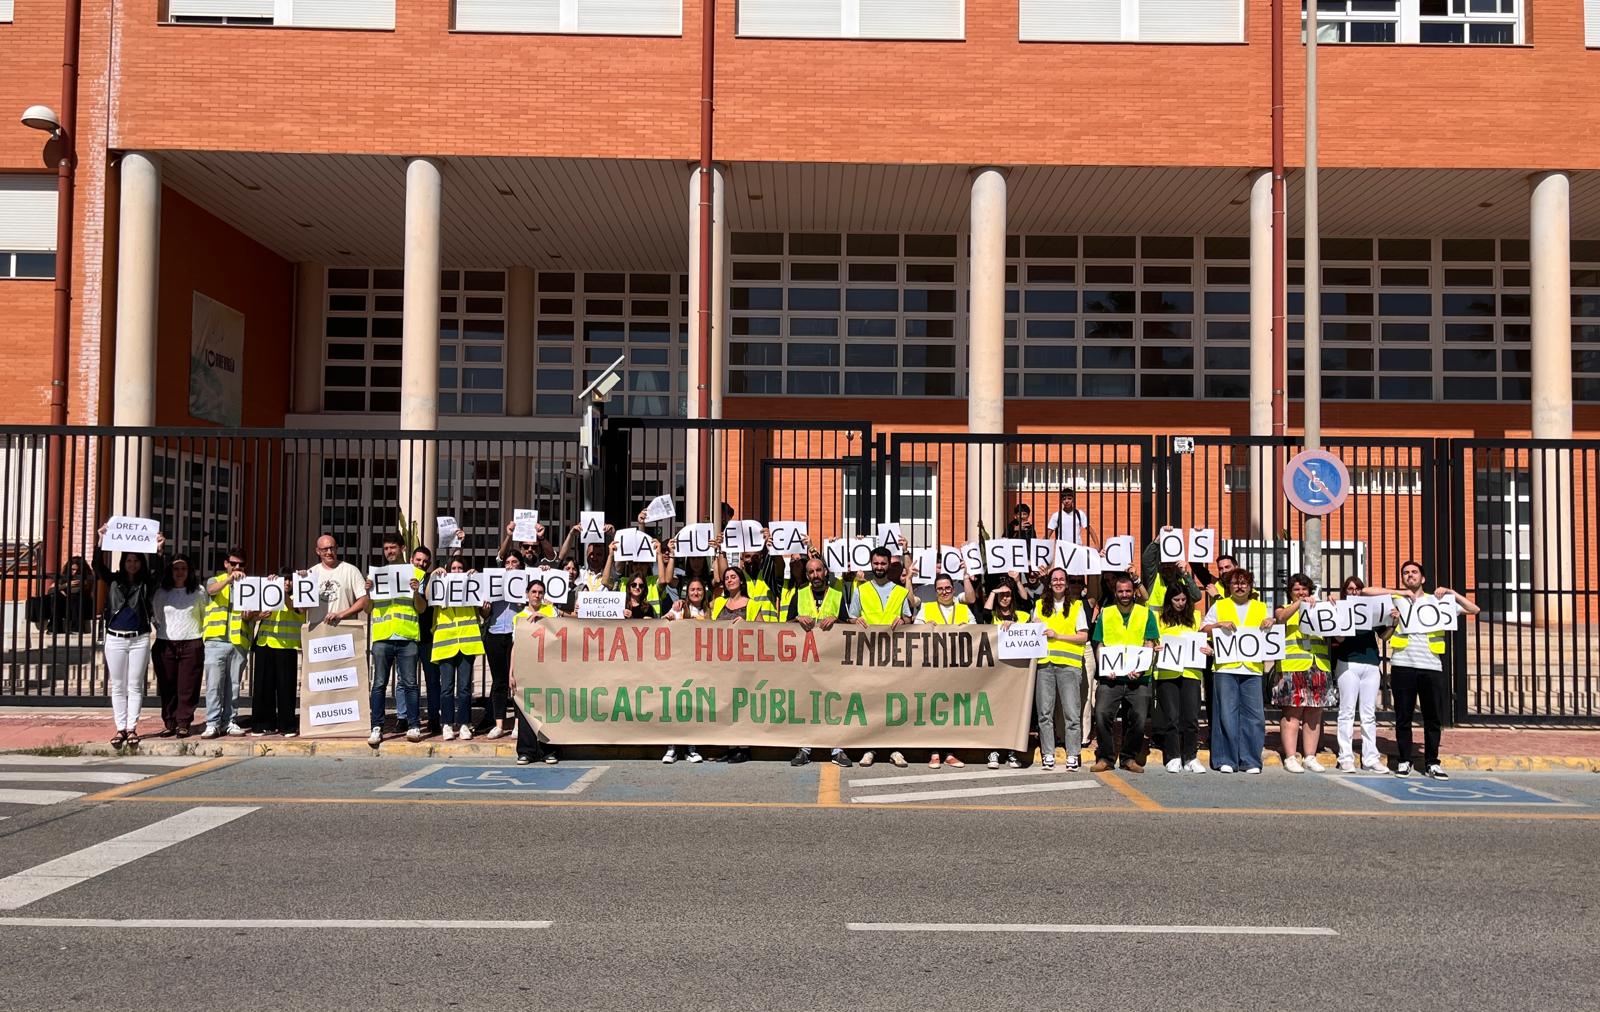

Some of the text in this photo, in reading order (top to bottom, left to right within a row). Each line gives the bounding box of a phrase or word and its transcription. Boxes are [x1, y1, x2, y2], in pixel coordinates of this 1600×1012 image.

[116, 522, 148, 531] DRET A
[111, 533, 150, 542] LA VAGA
[583, 518, 602, 539] A
[621, 536, 654, 557] LA
[676, 527, 805, 554] HUELGA
[827, 544, 871, 568] NO
[883, 529, 900, 550] A
[239, 580, 316, 607] POR
[375, 571, 410, 595] EL
[586, 610, 618, 618] HUELGA
[1008, 629, 1028, 637] DRET
[313, 643, 347, 655] SERVEIS
[531, 627, 995, 668] 11 MAYO HUELGA INDEFINIDA
[1017, 640, 1040, 648] VAGA
[317, 673, 349, 685] MÍNIMS
[523, 679, 995, 727] EDUCACIÓN PÚBLICA DIGNA
[315, 707, 353, 719] ABUSIUS
